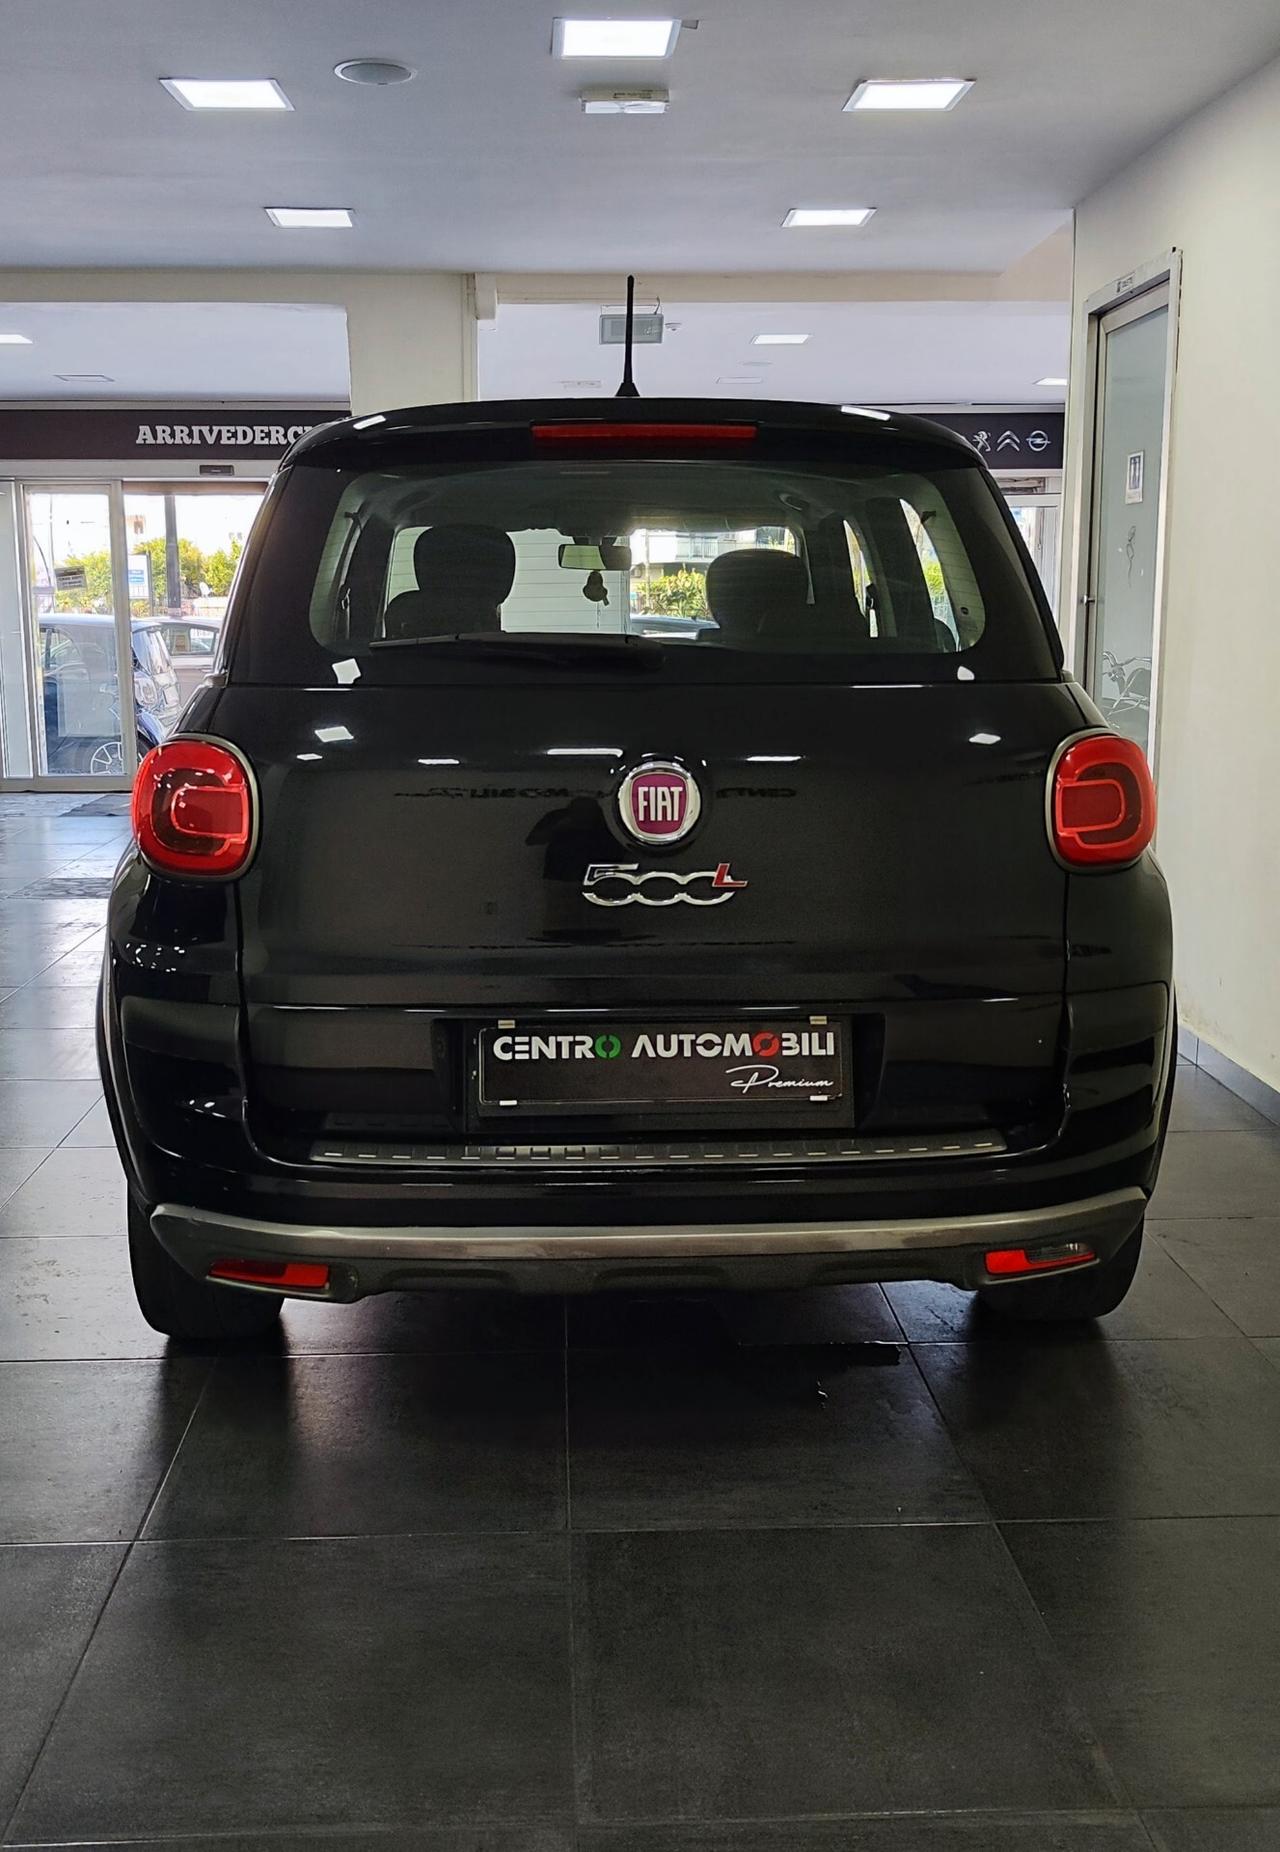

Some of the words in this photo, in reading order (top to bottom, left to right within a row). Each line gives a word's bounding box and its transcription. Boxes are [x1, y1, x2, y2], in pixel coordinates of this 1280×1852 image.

[136, 425, 313, 445] ARRIVEDERC
[638, 786, 683, 822] FIAT
[582, 863, 748, 907] 500L
[493, 1034, 622, 1060] CENTRO
[631, 1031, 835, 1058] AUTOMOBILI
[725, 1064, 834, 1094] Premium
